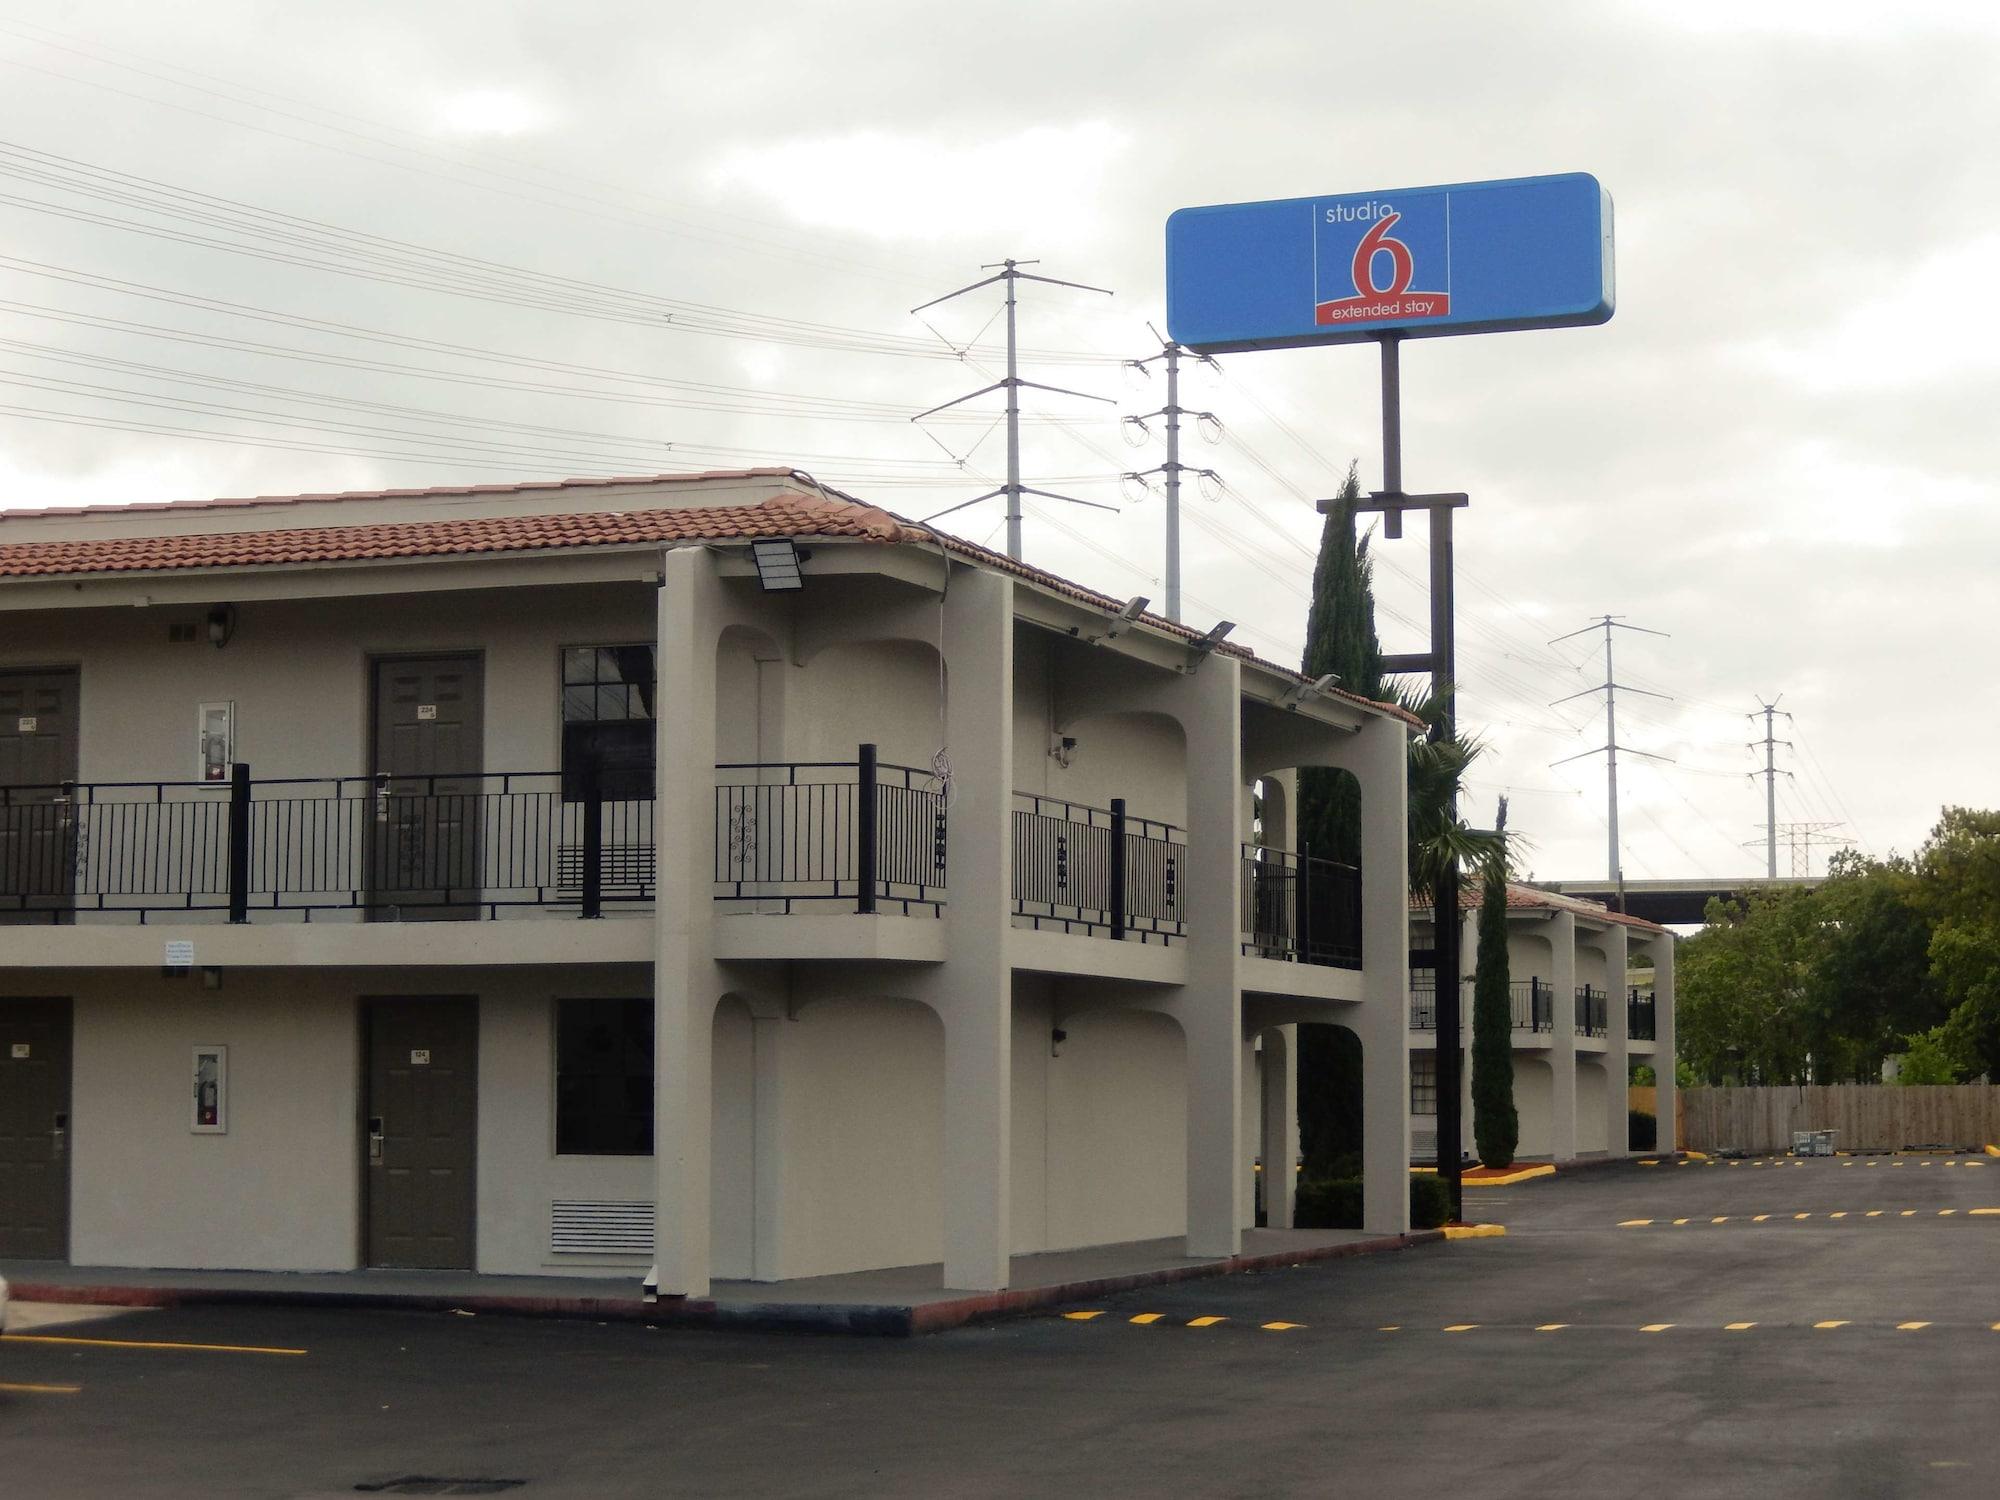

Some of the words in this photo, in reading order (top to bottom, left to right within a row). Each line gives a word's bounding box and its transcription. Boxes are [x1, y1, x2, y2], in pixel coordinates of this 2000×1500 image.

[1326, 200, 1394, 223] studio
[1351, 212, 1414, 298] 6
[1332, 301, 1400, 319] extended
[1405, 300, 1434, 316] stay
